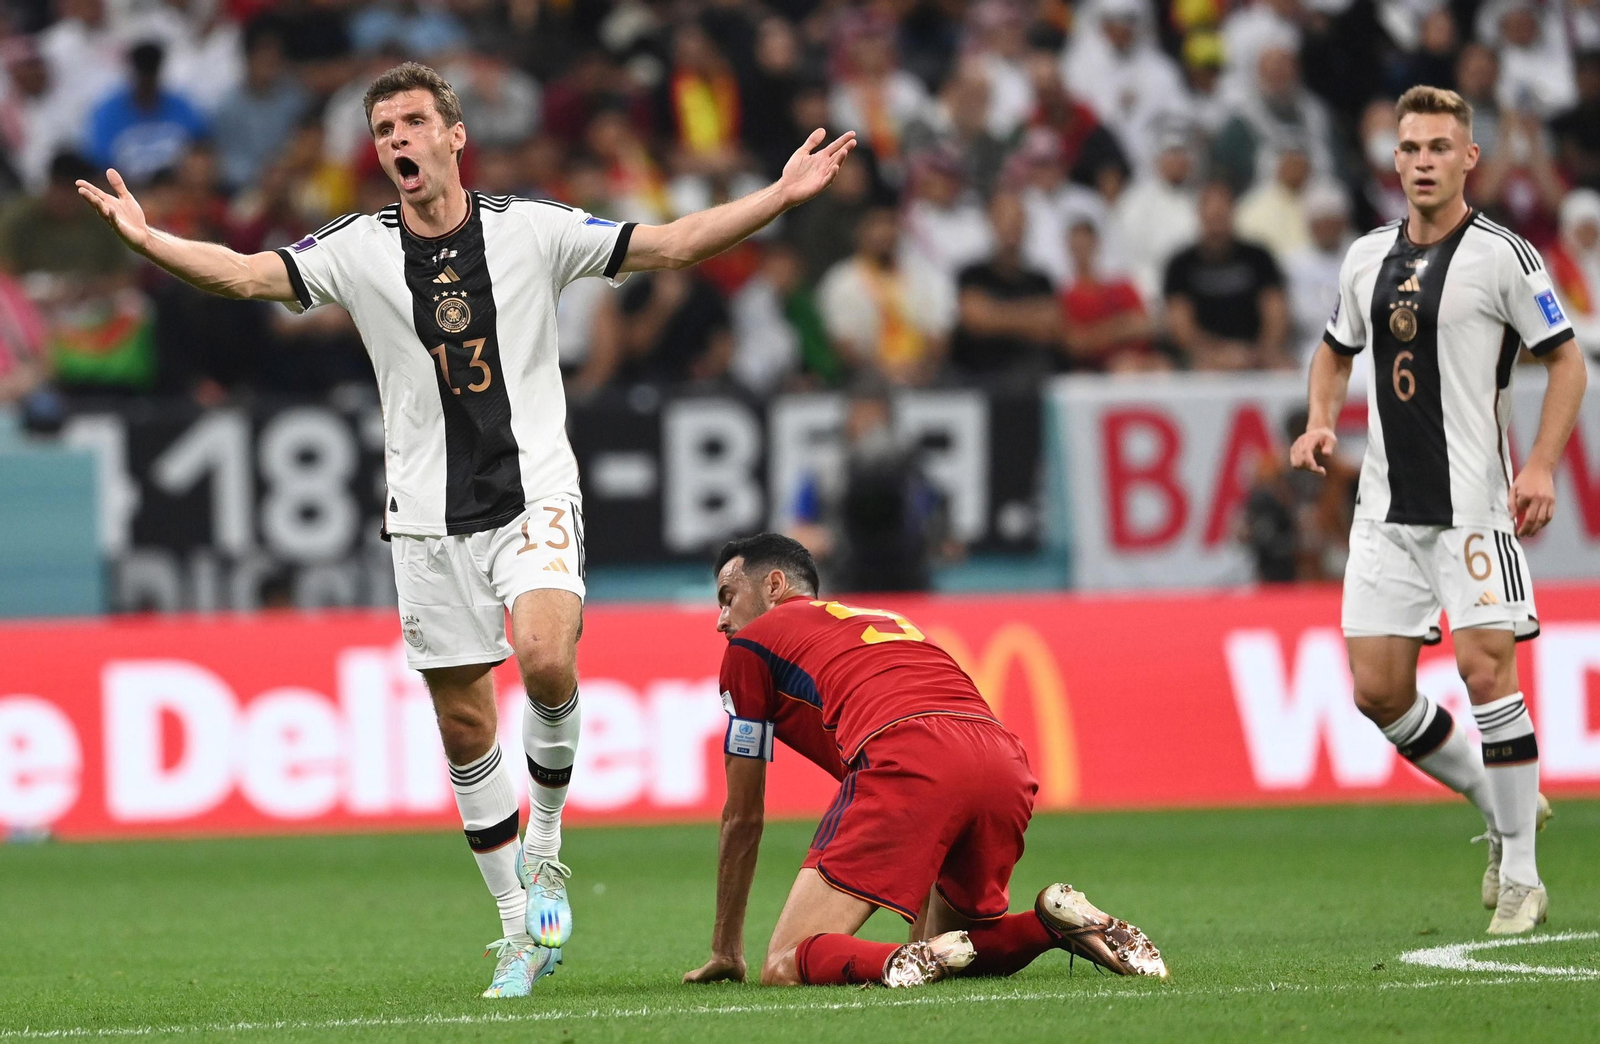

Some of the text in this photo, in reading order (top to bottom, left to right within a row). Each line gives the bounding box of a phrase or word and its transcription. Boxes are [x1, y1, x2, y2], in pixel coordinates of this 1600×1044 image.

[430, 337, 493, 395] 13
[1392, 351, 1416, 401] 6
[153, 405, 385, 556] 18
[516, 506, 570, 556] 13
[1463, 533, 1492, 581] 6
[99, 634, 728, 823] Delier
[537, 769, 568, 781] DFB
